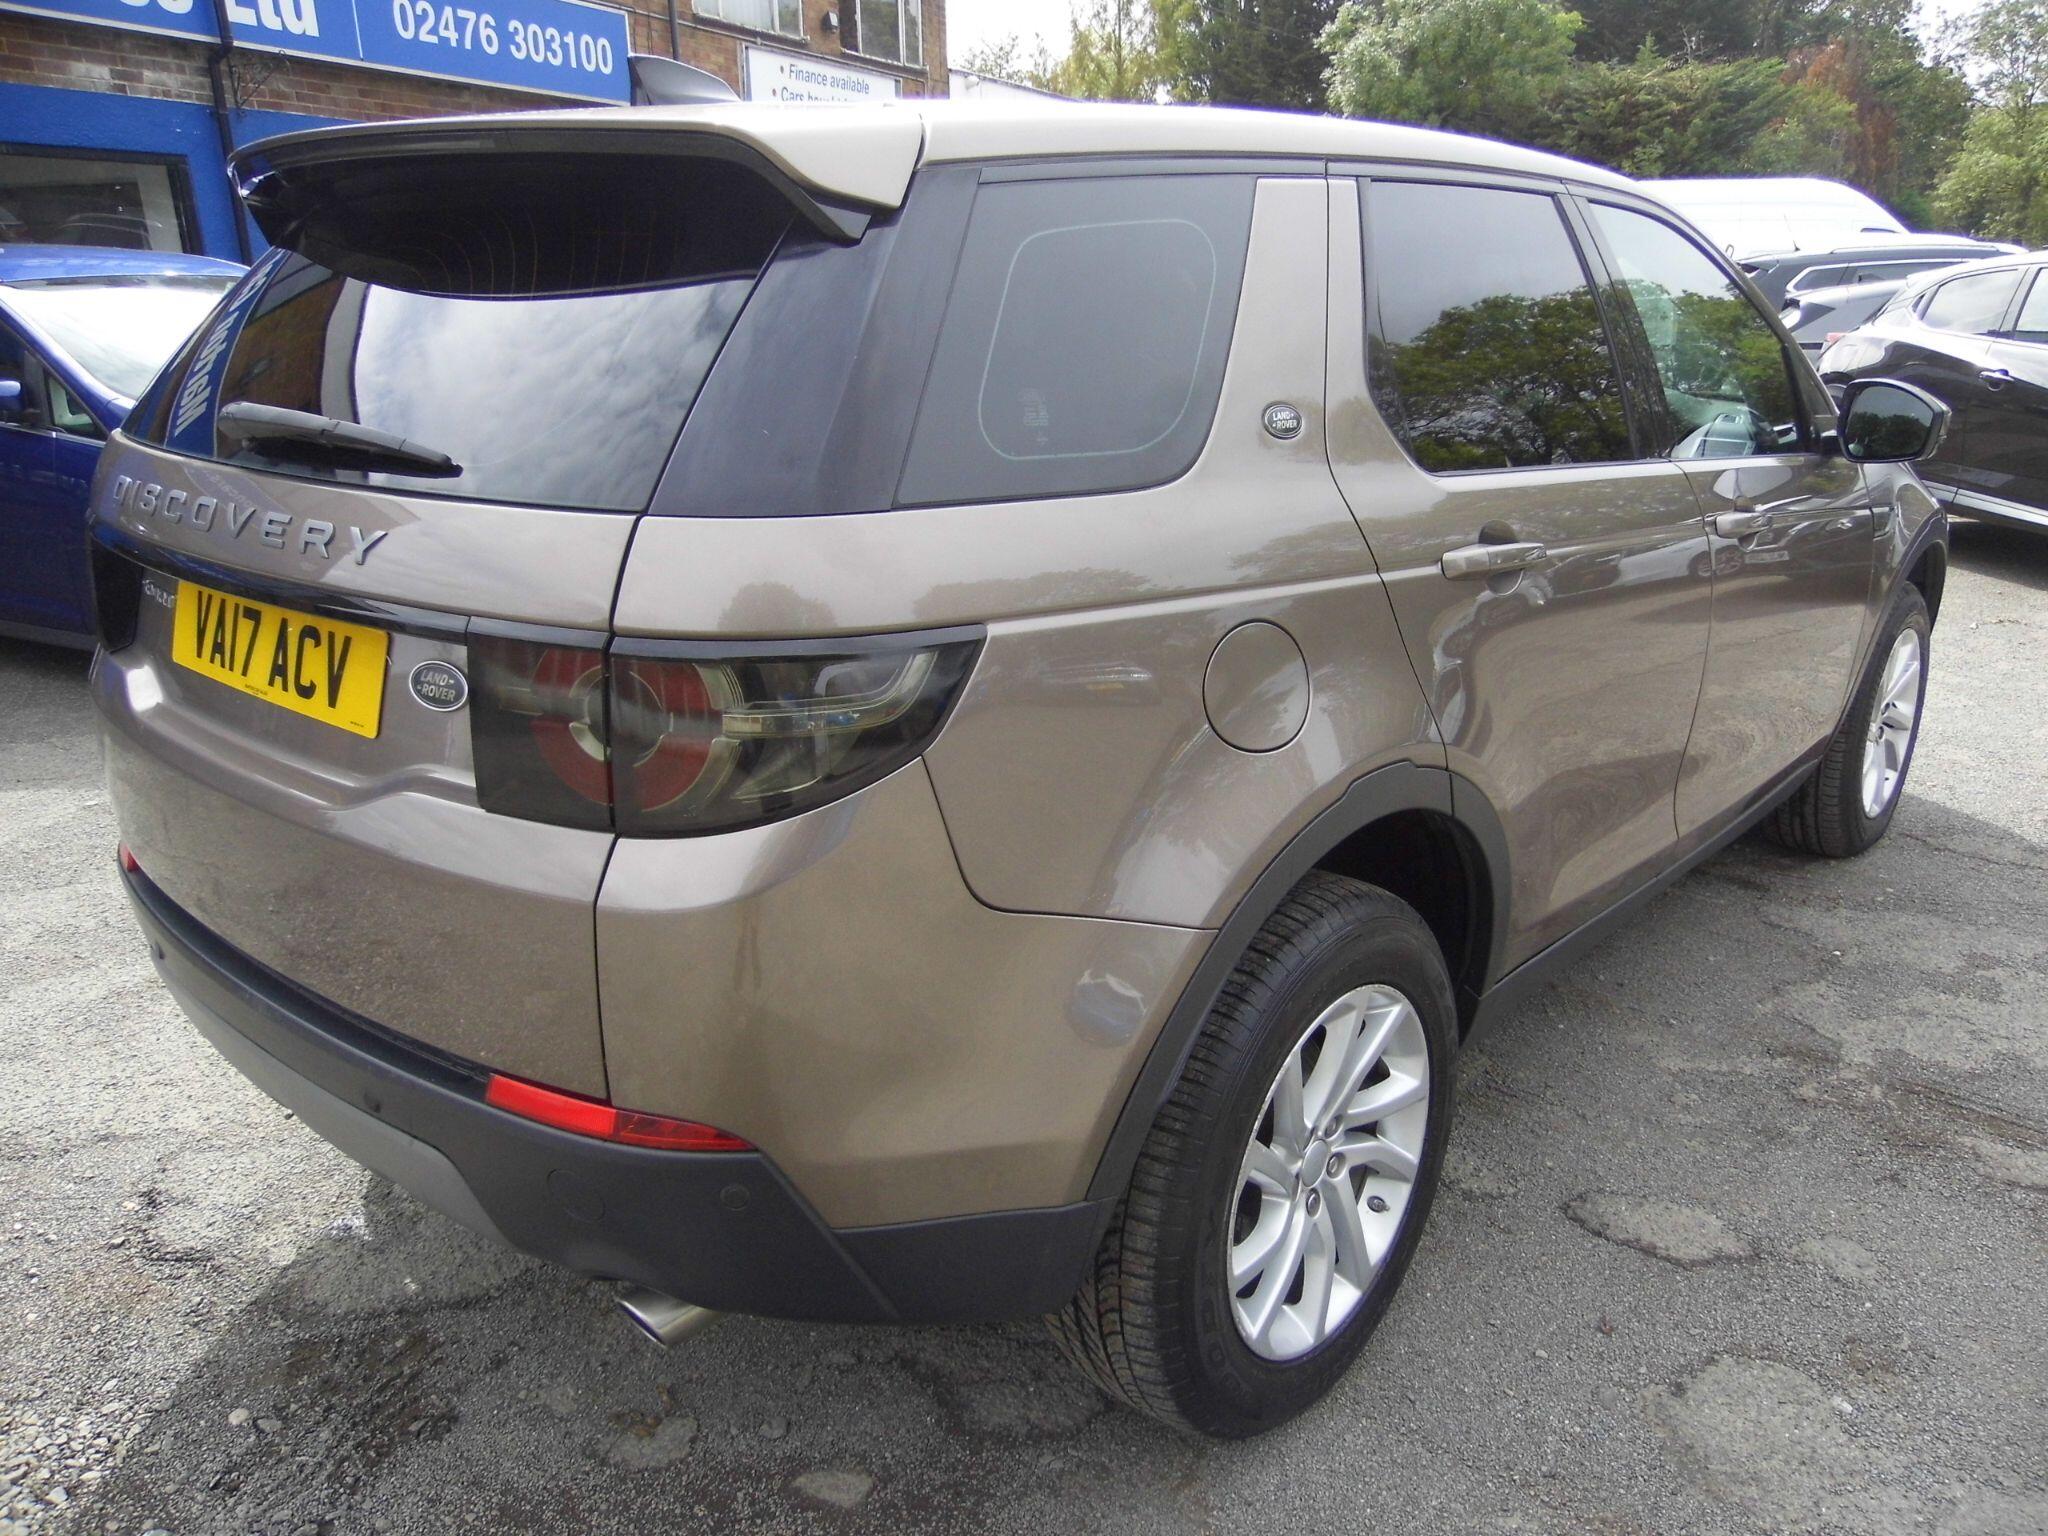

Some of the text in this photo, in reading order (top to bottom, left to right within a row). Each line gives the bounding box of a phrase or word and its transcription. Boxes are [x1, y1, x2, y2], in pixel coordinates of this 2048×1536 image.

[393, 0, 613, 75] 02476 303100
[788, 63, 870, 95] Finance available
[112, 474, 388, 565] DISCOVERY
[196, 590, 353, 710] VA17 ACV
